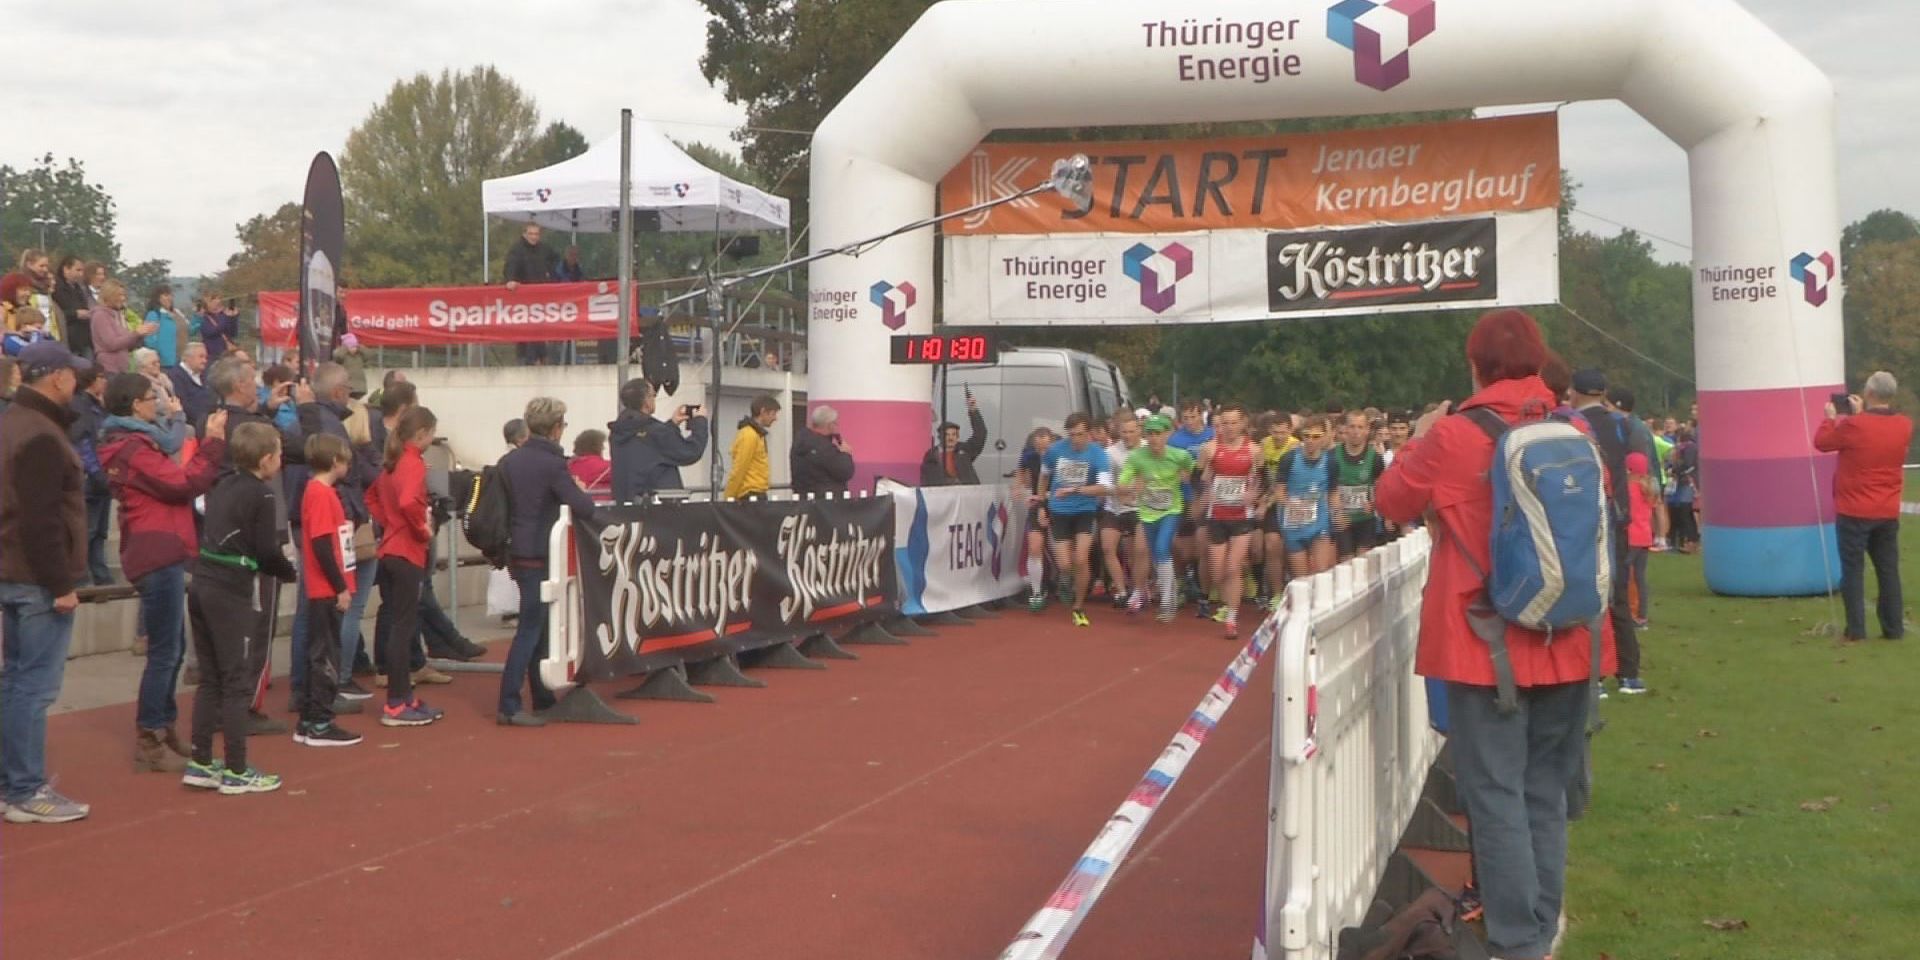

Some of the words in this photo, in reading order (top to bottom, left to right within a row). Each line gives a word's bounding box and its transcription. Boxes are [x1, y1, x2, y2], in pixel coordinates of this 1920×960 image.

[1142, 17, 1300, 49] Thüringer
[1178, 48, 1301, 83] Energie
[1312, 142, 1422, 174] Jenaer
[1061, 148, 1288, 219] START
[1316, 164, 1537, 213] Kernberglauf
[1002, 253, 1107, 278] Thüringer
[1279, 240, 1484, 301] Köstritzer
[1700, 264, 1776, 283] Thüringer
[1026, 280, 1107, 303] Energie
[1712, 283, 1776, 302] Energie
[351, 314, 384, 328] Geld
[387, 314, 419, 329] geht
[428, 299, 578, 331] Sparkasse
[813, 304, 858, 322] Energie
[948, 521, 984, 570] TEAG
[597, 521, 758, 659] Köstritzer
[778, 514, 886, 624] Köstritzer
